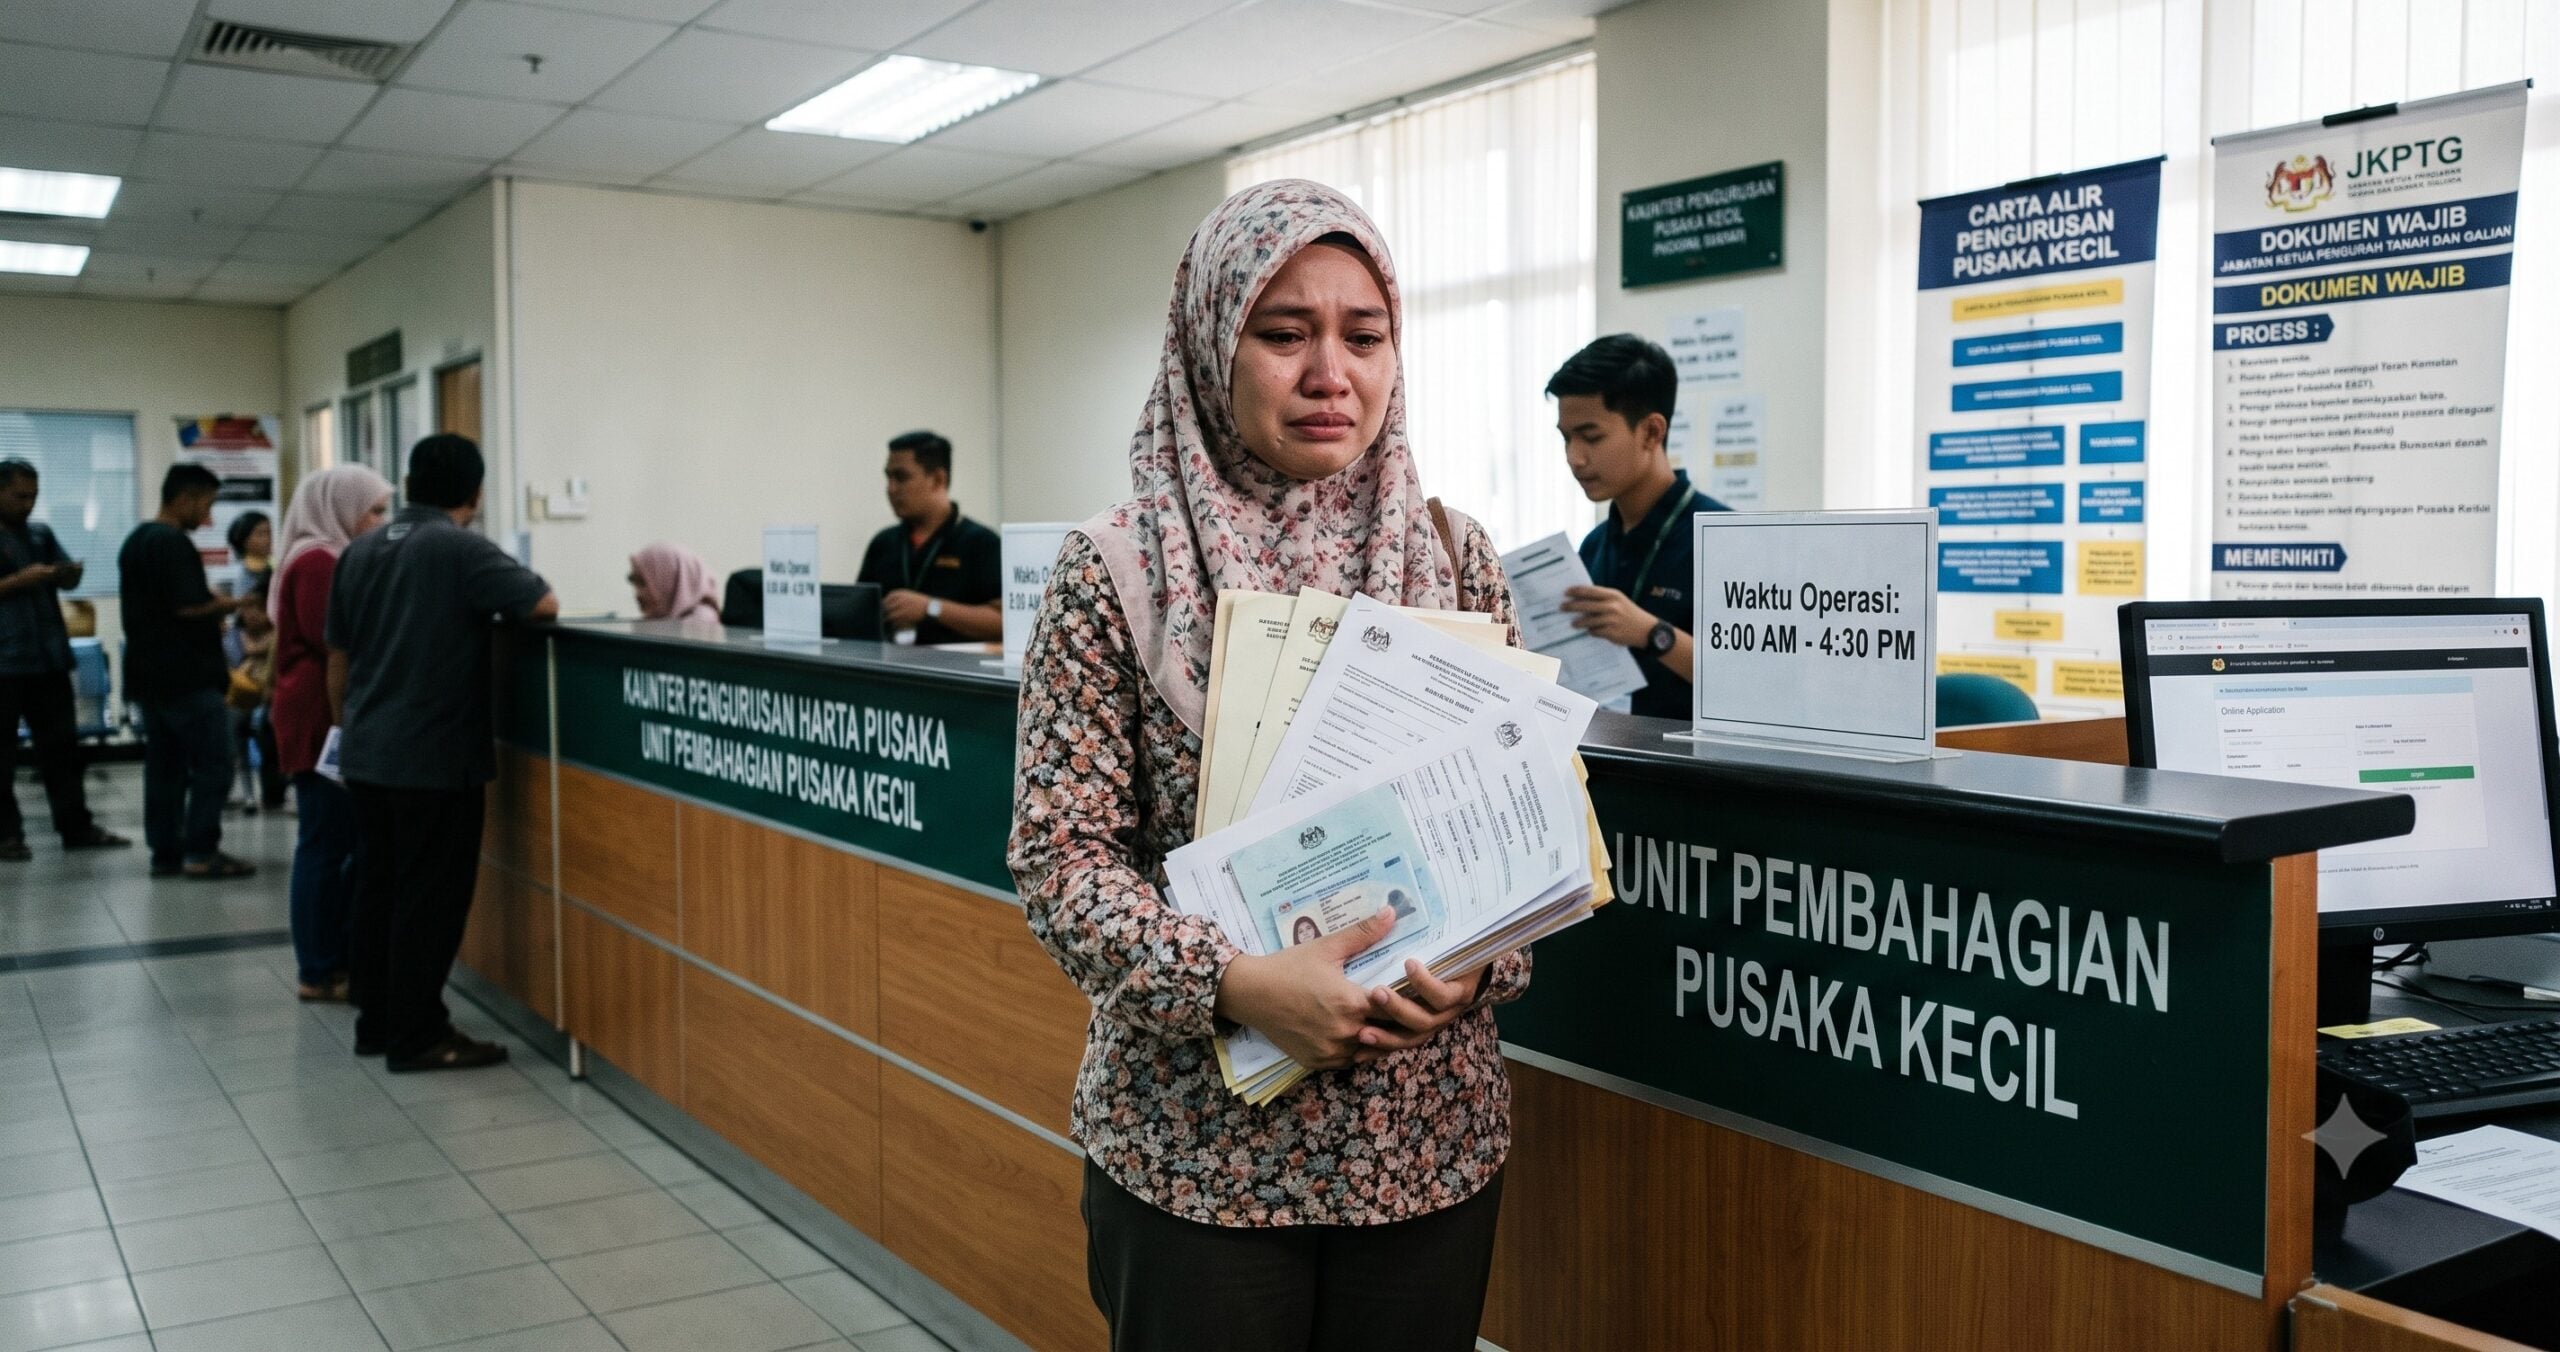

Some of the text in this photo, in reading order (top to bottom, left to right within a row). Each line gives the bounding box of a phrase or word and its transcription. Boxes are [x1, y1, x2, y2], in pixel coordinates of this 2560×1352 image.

[2347, 136, 2463, 178] JKPTG
[1968, 184, 2103, 227] CARTA ALIR
[1956, 208, 2114, 254] PENGURUSAN
[2220, 256, 2273, 272] JABATAN
[2275, 250, 2315, 266] KETUA
[2386, 235, 2429, 251] TANAH
[2432, 231, 2461, 246] DAN
[2463, 225, 2512, 242] GALIAN
[2260, 205, 2467, 253] DOKUMEN WAJIB
[1953, 236, 2120, 279] PUSAKA KECIL
[2261, 265, 2465, 306] DOKUMEN WAJIB
[2226, 321, 2308, 345] PROESS
[1724, 581, 1900, 619] Waktu Operasi:
[1711, 622, 1755, 652] 8:00
[1761, 624, 1798, 654] AM
[1819, 627, 1869, 658] 4:30
[1877, 629, 1916, 660] PM
[623, 667, 950, 770] KAUNTER PENGURUSAN HARTA PUSAKA
[2221, 704, 2286, 717] Online Application
[641, 720, 924, 832] UNIT PEMBAHAGIAN PUSAKA KECIL
[1614, 832, 2170, 1013] UNIT PEMBAHAGIAN
[1675, 946, 2079, 1120] PUSAKA KECIL
